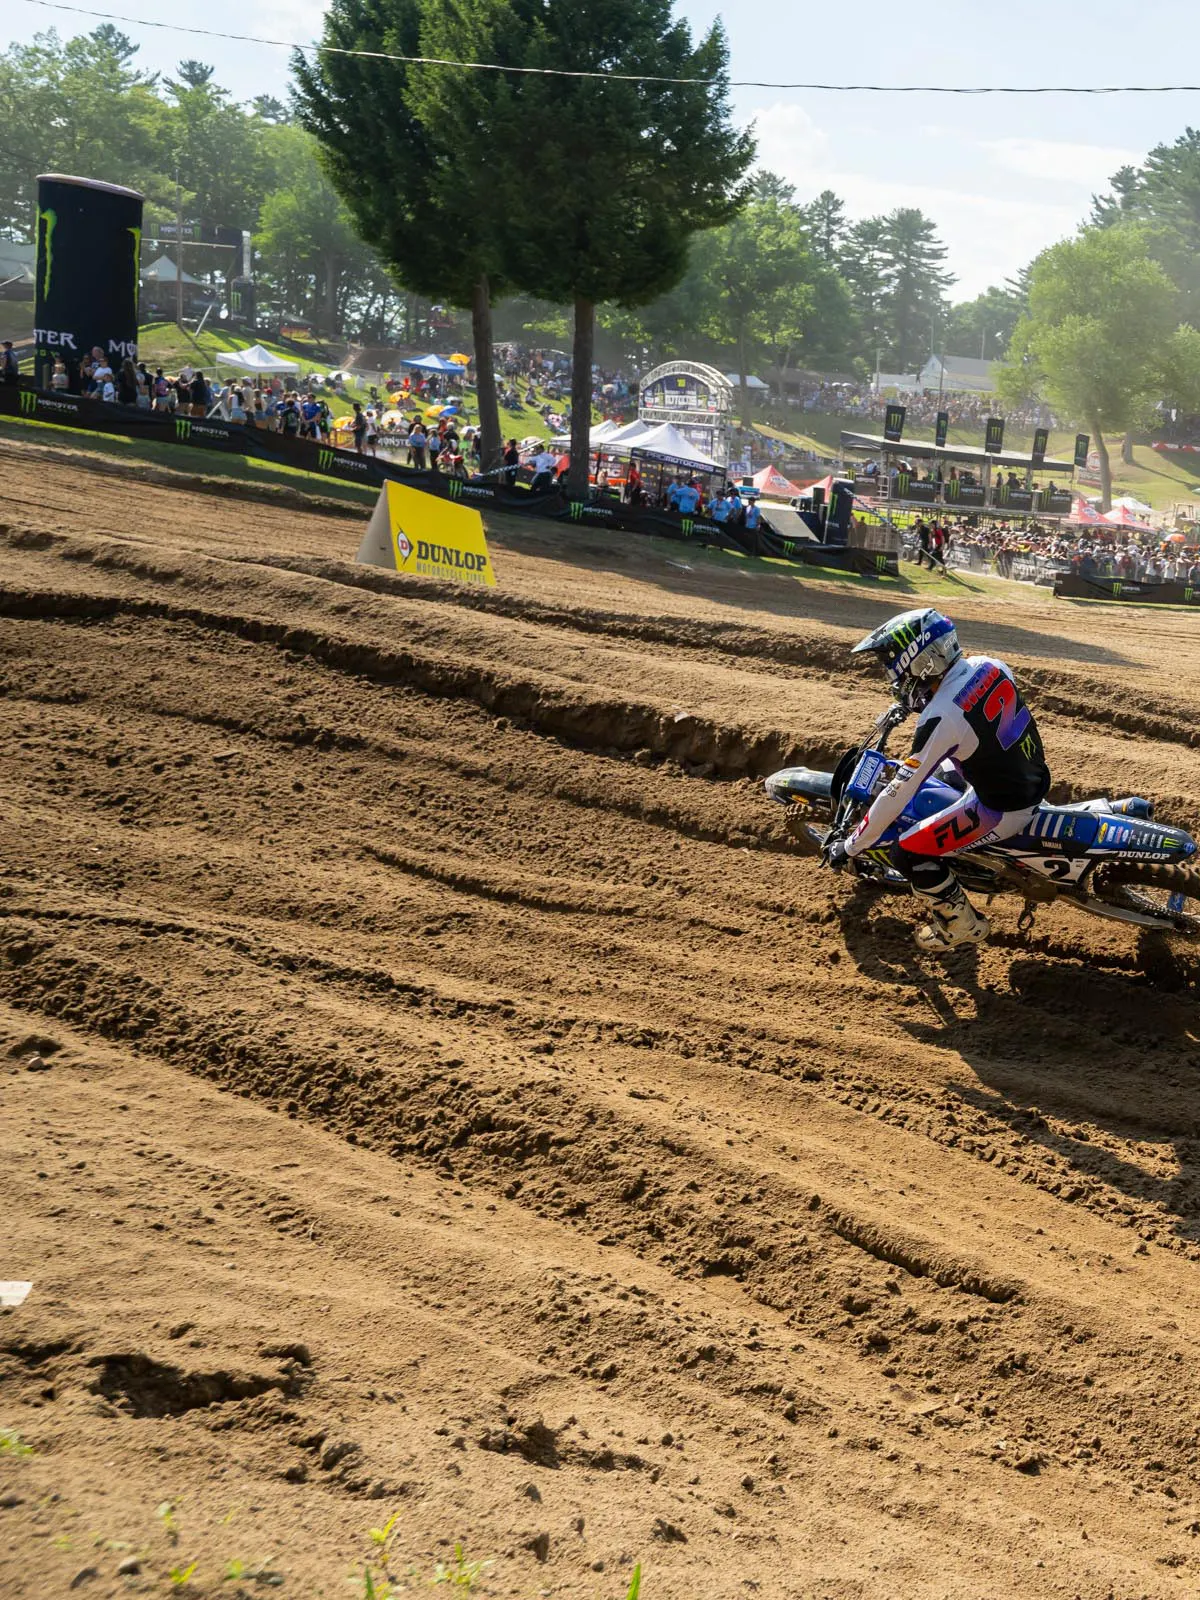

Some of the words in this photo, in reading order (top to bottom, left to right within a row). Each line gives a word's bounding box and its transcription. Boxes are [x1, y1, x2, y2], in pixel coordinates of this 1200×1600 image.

[417, 541, 487, 572] DUNLOP
[895, 631, 931, 674] 100%
[952, 661, 1000, 713] WEBB
[983, 678, 1031, 751] 2
[855, 756, 881, 788] PROTAPER
[933, 803, 980, 849] FLY
[1043, 860, 1071, 880] 2
[1117, 850, 1172, 860] DUNLOP
